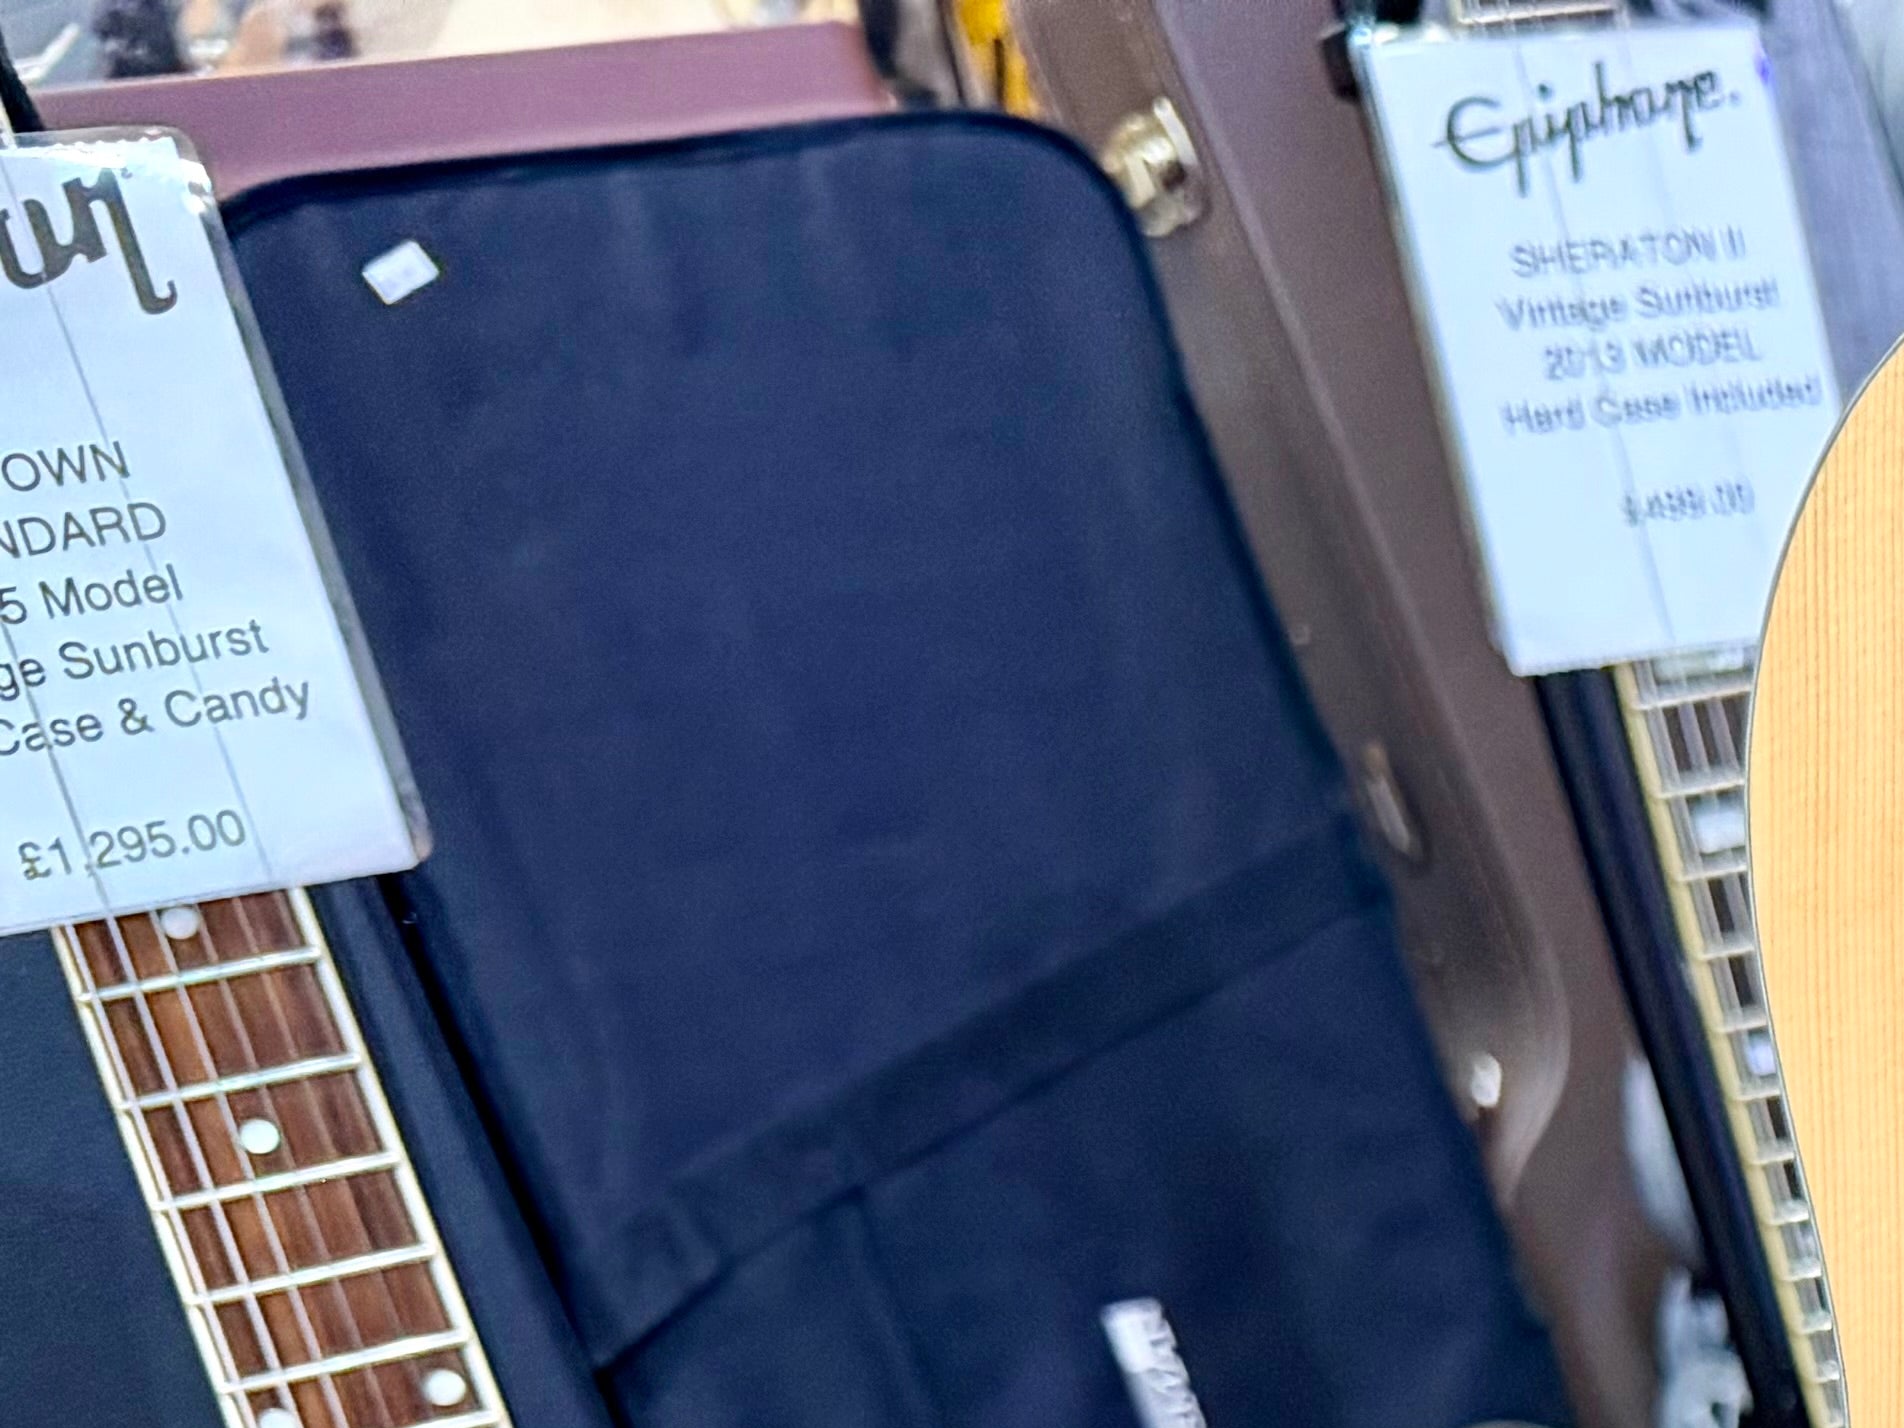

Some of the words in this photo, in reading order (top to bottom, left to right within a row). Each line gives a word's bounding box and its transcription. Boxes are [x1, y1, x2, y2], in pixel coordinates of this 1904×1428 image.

[1510, 228, 1717, 278] SHERATON
[1495, 292, 1629, 332] Vintage
[1634, 276, 1779, 319] Sunburst
[1633, 328, 1762, 368] MODEL
[1500, 394, 1587, 435] Hard
[1590, 391, 1682, 428] Case
[1685, 373, 1823, 415] Included
[1, 441, 130, 492] OWN
[39, 563, 184, 619] Model
[58, 619, 270, 681] Sunburst
[118, 698, 156, 736] &
[164, 676, 311, 729] Candy
